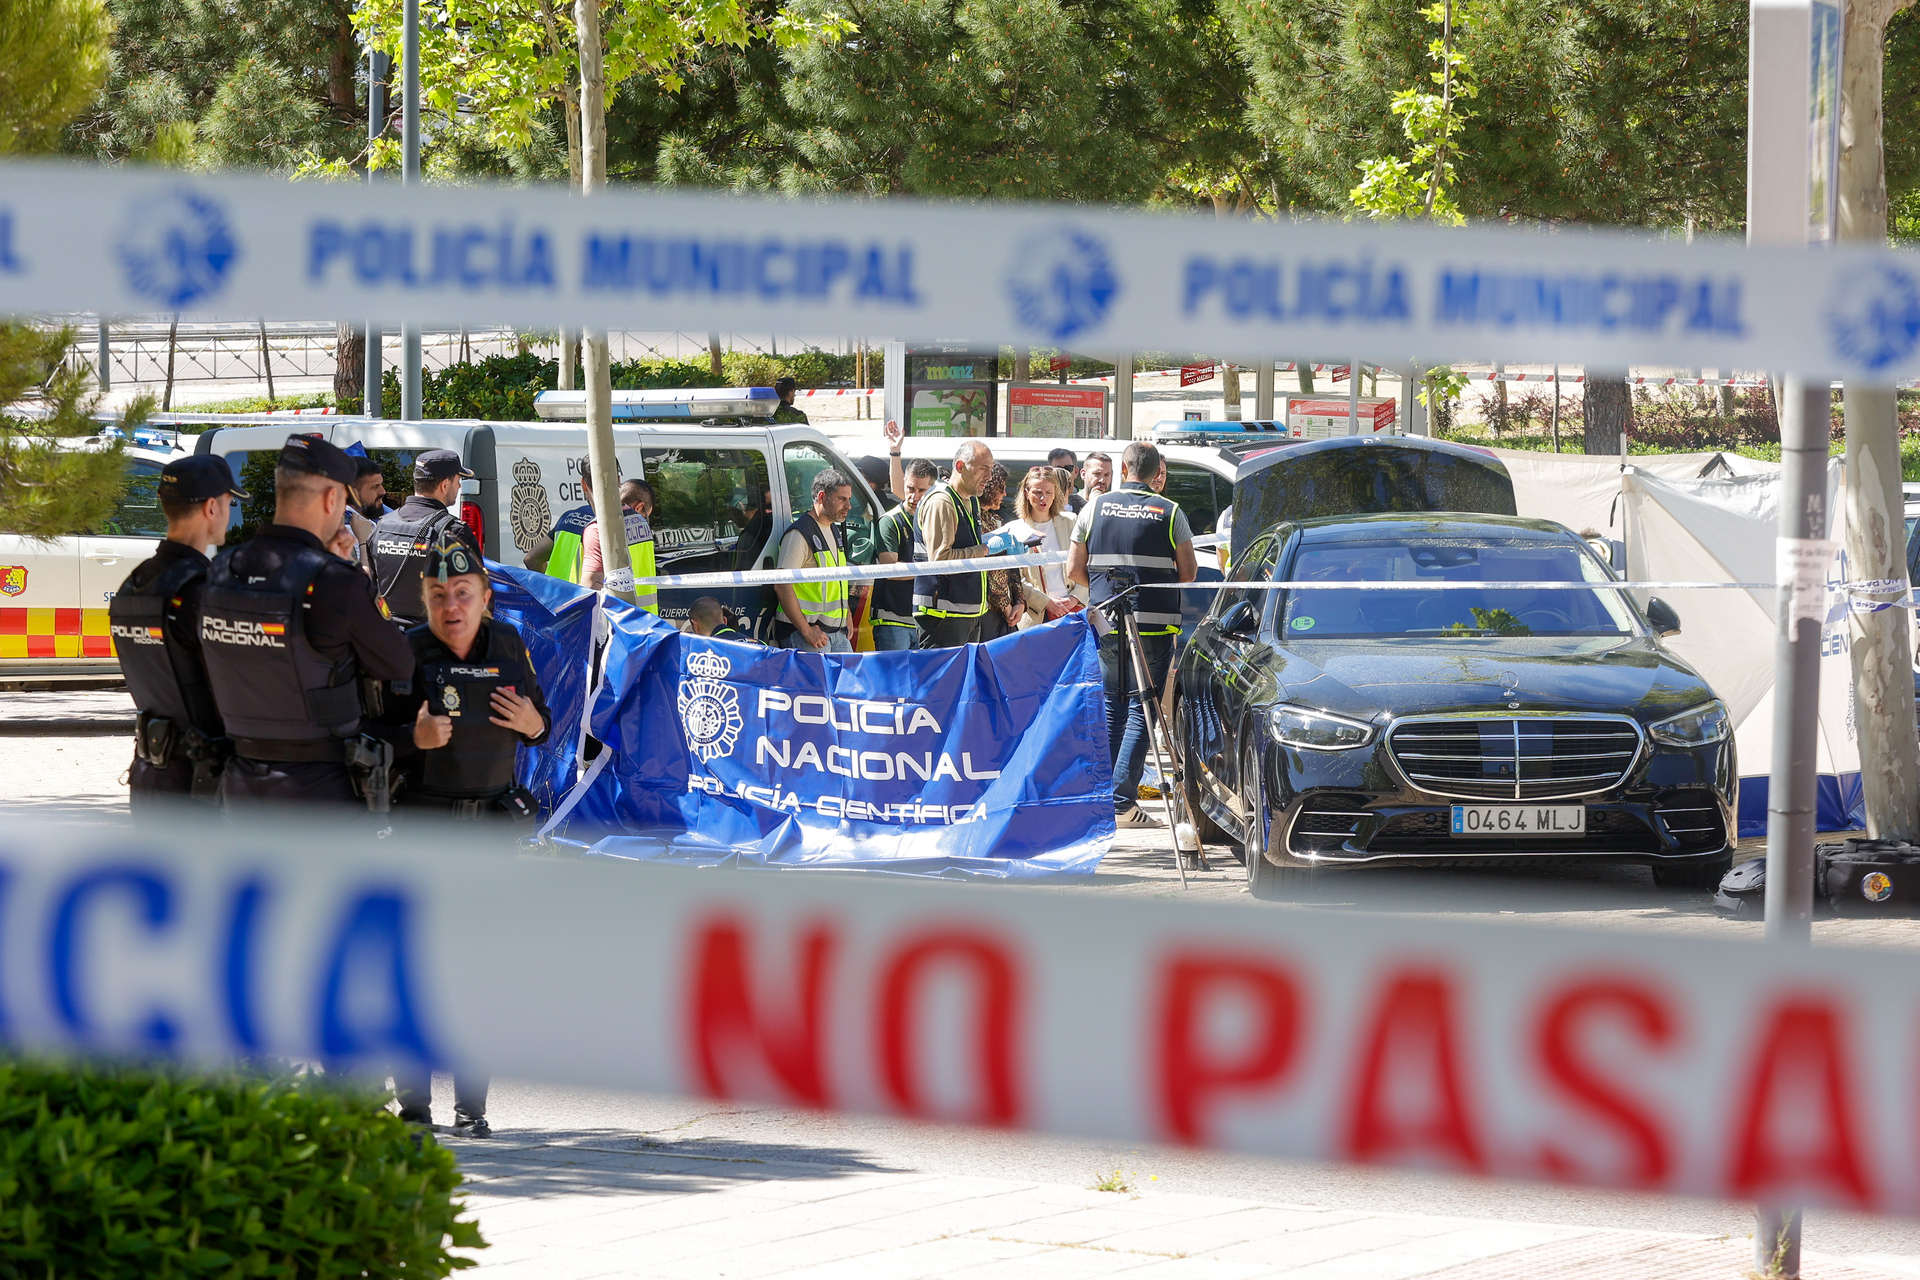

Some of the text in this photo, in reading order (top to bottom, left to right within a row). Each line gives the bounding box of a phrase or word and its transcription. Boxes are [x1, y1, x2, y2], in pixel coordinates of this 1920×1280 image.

[307, 219, 921, 307] POLICÍA MUNICIPAL
[1183, 254, 1745, 338] POLICÍA MUNICIPAL
[1101, 509, 1163, 521] NACIONAL
[1102, 502, 1150, 512] POLICIA
[378, 540, 416, 549] POLICIA
[378, 547, 427, 557] NACIONAL
[734, 607, 746, 616] DE
[111, 625, 151, 637] POLICIA
[203, 616, 265, 634] POLICIA
[202, 628, 285, 647] NACIONAL
[451, 667, 489, 675] POLICIA
[757, 689, 942, 735] POLICÍA
[756, 735, 1001, 782] NACIONAL
[688, 774, 801, 813] POLICÍA
[816, 796, 987, 825] CIENTÍFICA
[1467, 809, 1581, 831] 0464 MLJ
[680, 914, 1920, 1215] NO PASA
